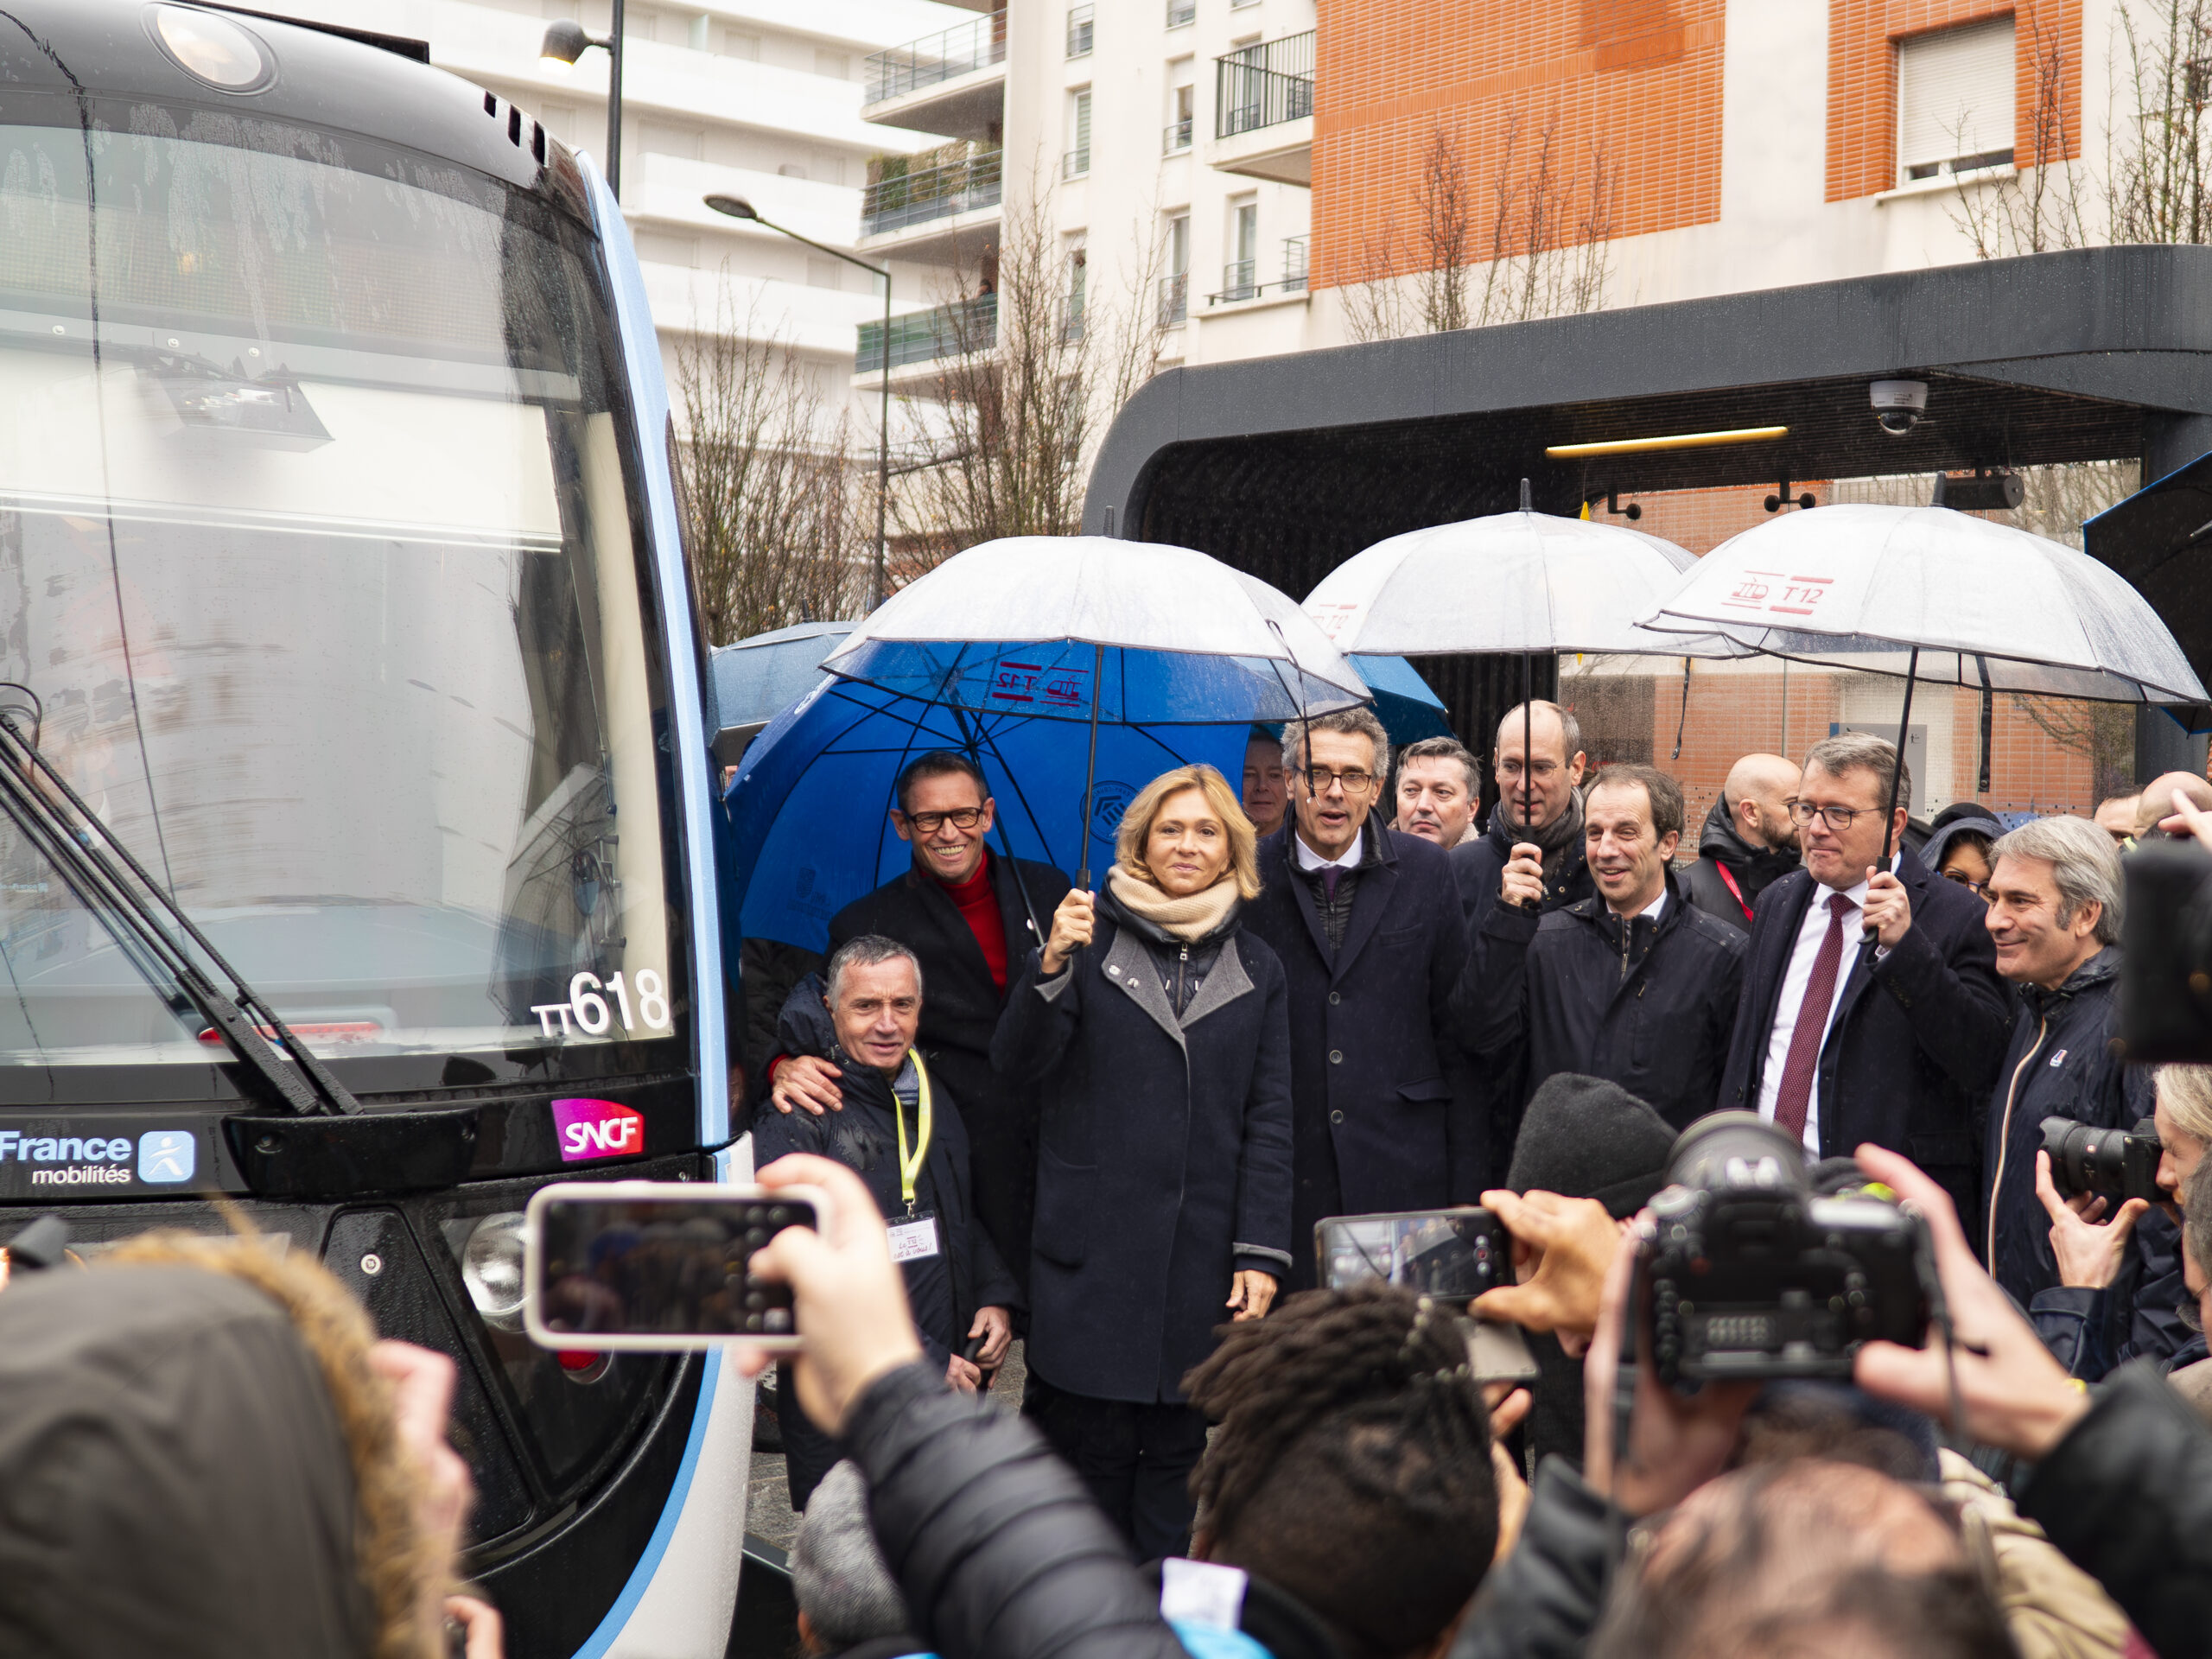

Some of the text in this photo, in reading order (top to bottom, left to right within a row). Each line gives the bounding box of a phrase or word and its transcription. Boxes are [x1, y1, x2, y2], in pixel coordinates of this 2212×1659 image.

[0, 1130, 131, 1161] France
[564, 1116, 638, 1153] SNCF
[31, 1163, 131, 1184] mobilités
